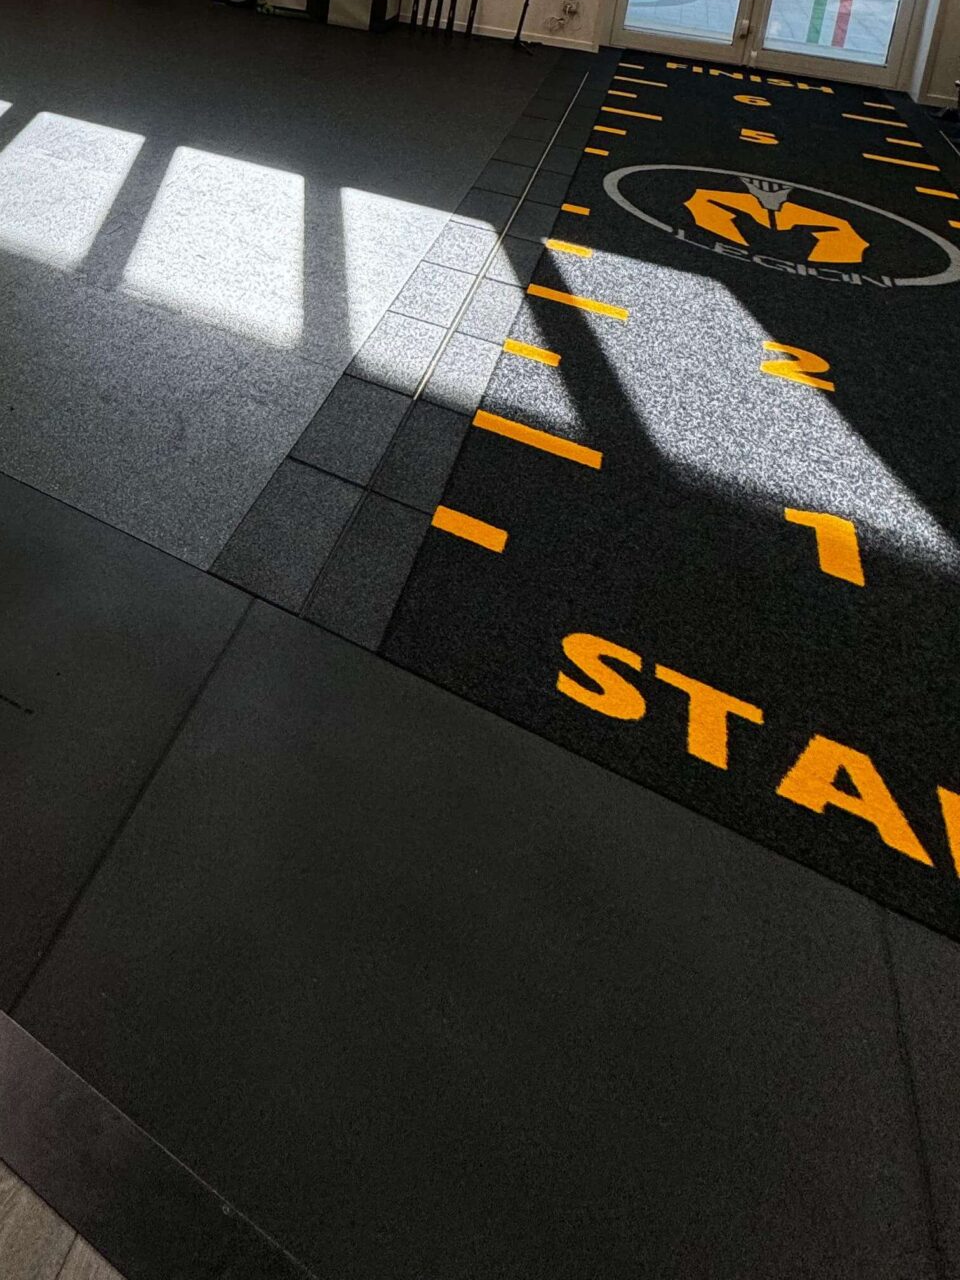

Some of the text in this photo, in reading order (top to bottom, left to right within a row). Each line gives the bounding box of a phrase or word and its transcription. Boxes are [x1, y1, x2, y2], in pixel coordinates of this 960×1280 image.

[666, 62, 835, 95] FINISH
[732, 94, 772, 107] 6
[739, 128, 780, 145] 5
[654, 228, 894, 288] LEGION
[759, 340, 836, 392] 2
[784, 507, 866, 587] 1
